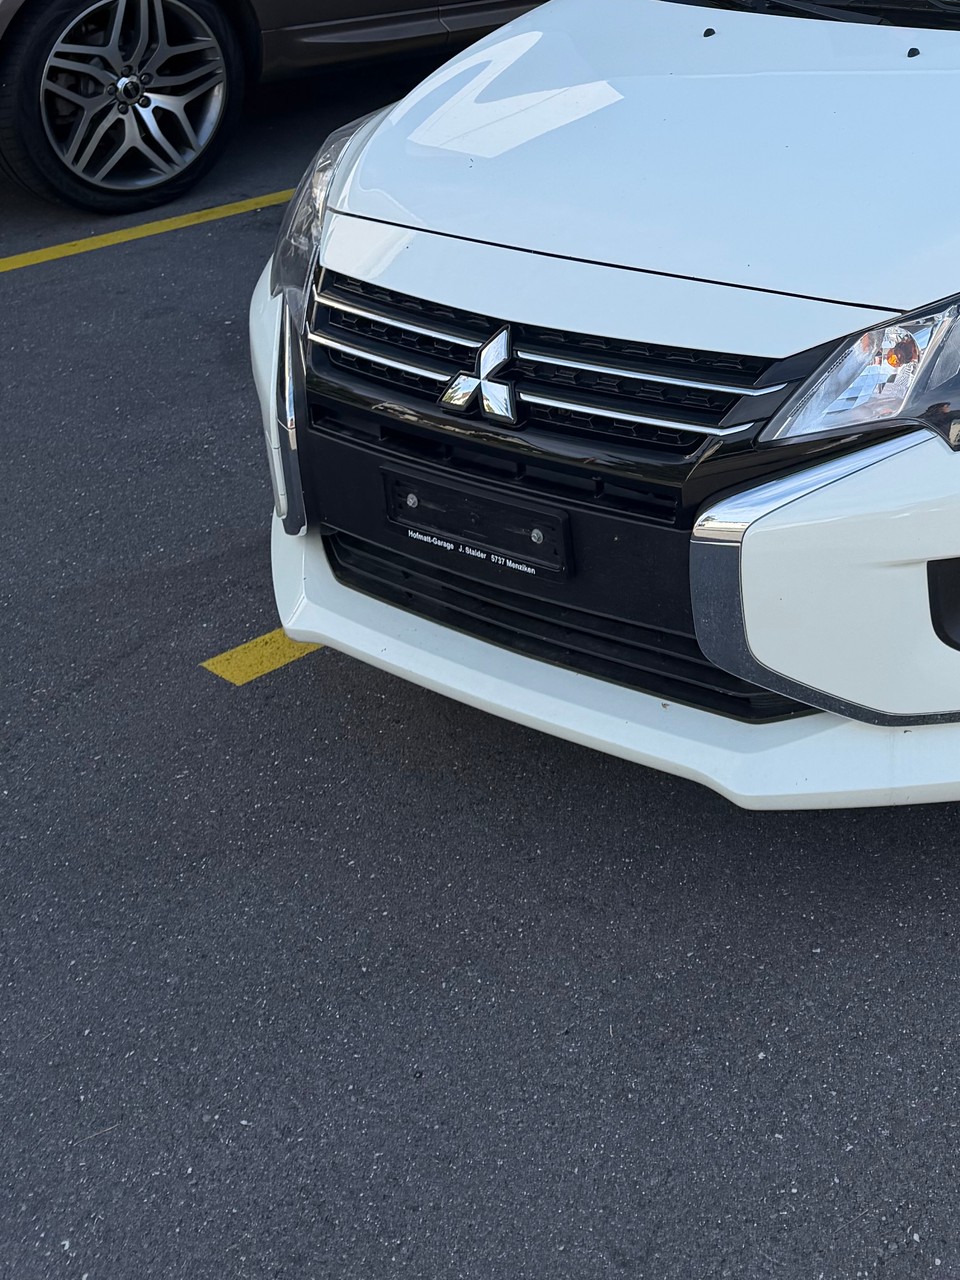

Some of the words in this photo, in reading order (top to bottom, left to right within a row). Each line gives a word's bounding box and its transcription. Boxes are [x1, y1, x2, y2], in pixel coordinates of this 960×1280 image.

[407, 529, 455, 551] Hofmatt-Garage
[458, 544, 465, 553] J.
[465, 546, 487, 560] Stalder
[490, 554, 505, 566] 5737
[506, 558, 536, 575] Menziken
